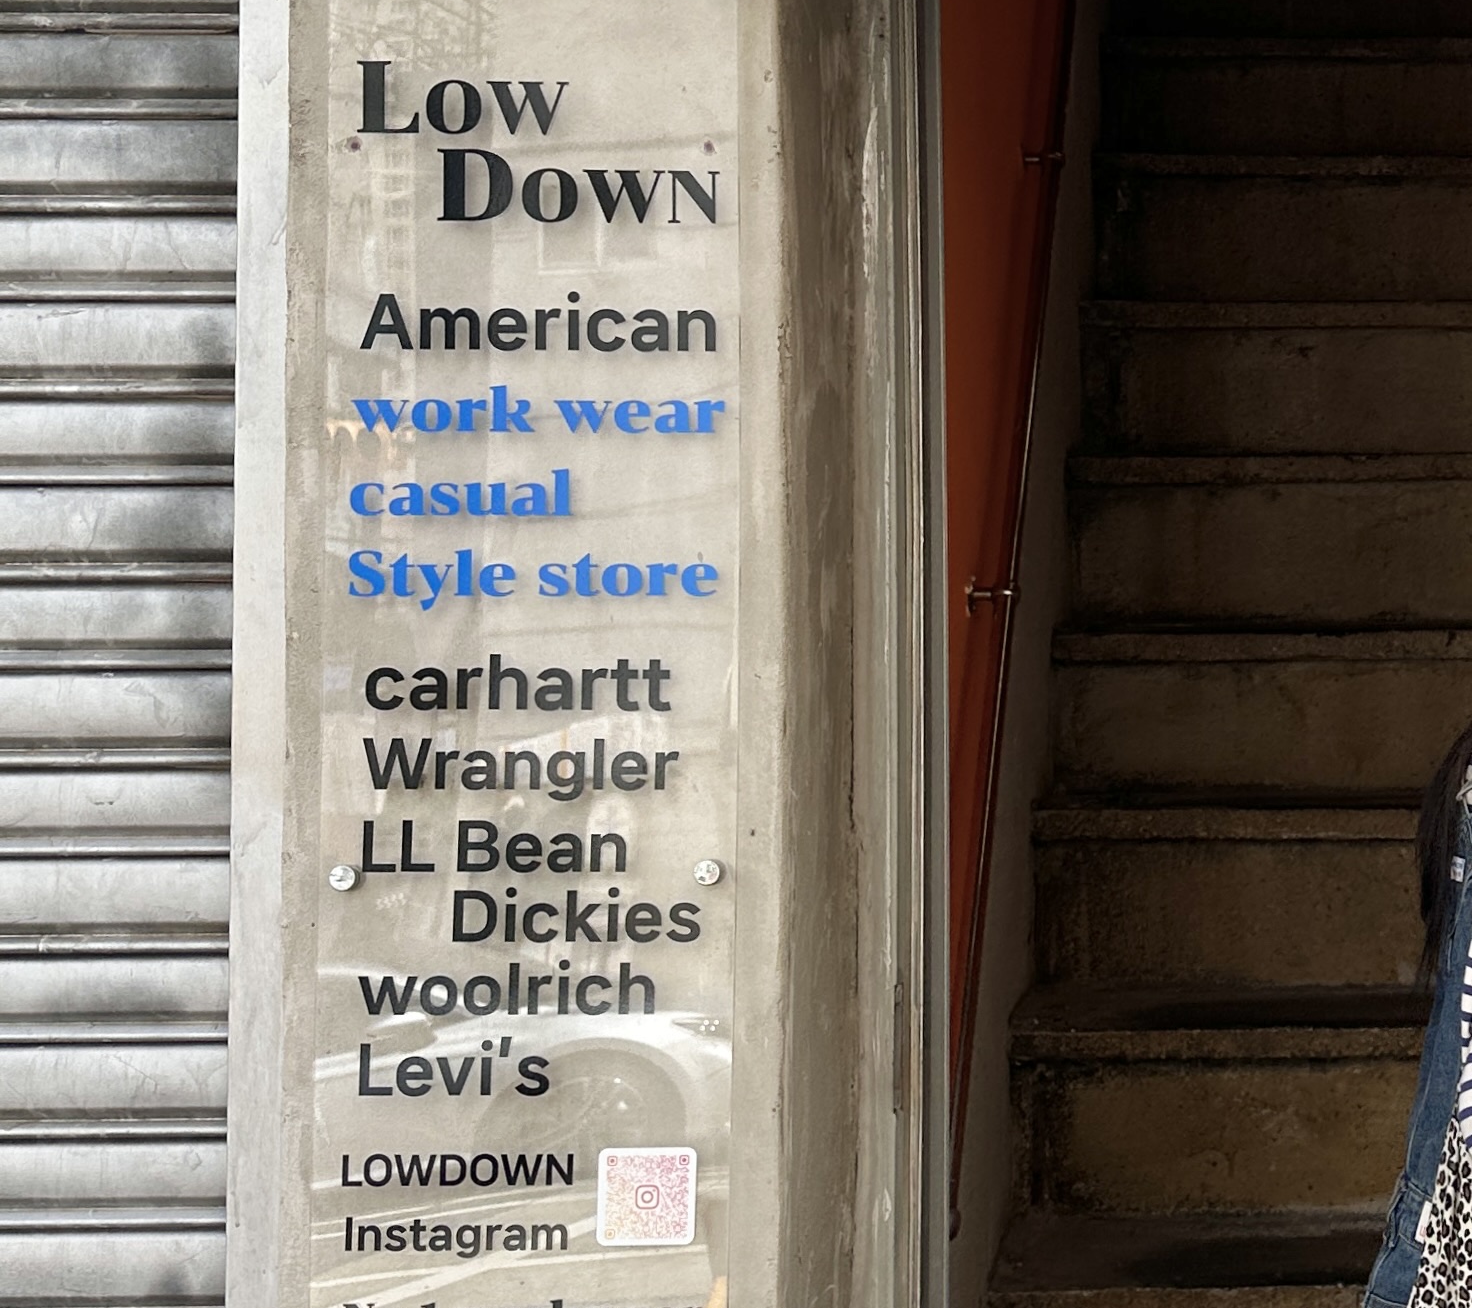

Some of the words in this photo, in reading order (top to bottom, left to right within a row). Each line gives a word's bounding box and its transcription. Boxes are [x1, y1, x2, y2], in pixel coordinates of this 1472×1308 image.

[360, 291, 718, 352] American
[350, 385, 533, 433] work
[554, 397, 726, 434] wear
[350, 468, 571, 516] casual
[349, 549, 517, 610] Style
[539, 552, 719, 596] store
[366, 653, 672, 711] carhartt
[363, 737, 681, 801] Wrangler
[362, 819, 436, 873] LL
[457, 820, 628, 873] Bean
[453, 886, 702, 943] Dickies
[359, 959, 656, 1015] woolrich
[342, 1153, 575, 1187] LOWDOWN
[345, 1216, 569, 1258] Instagram
